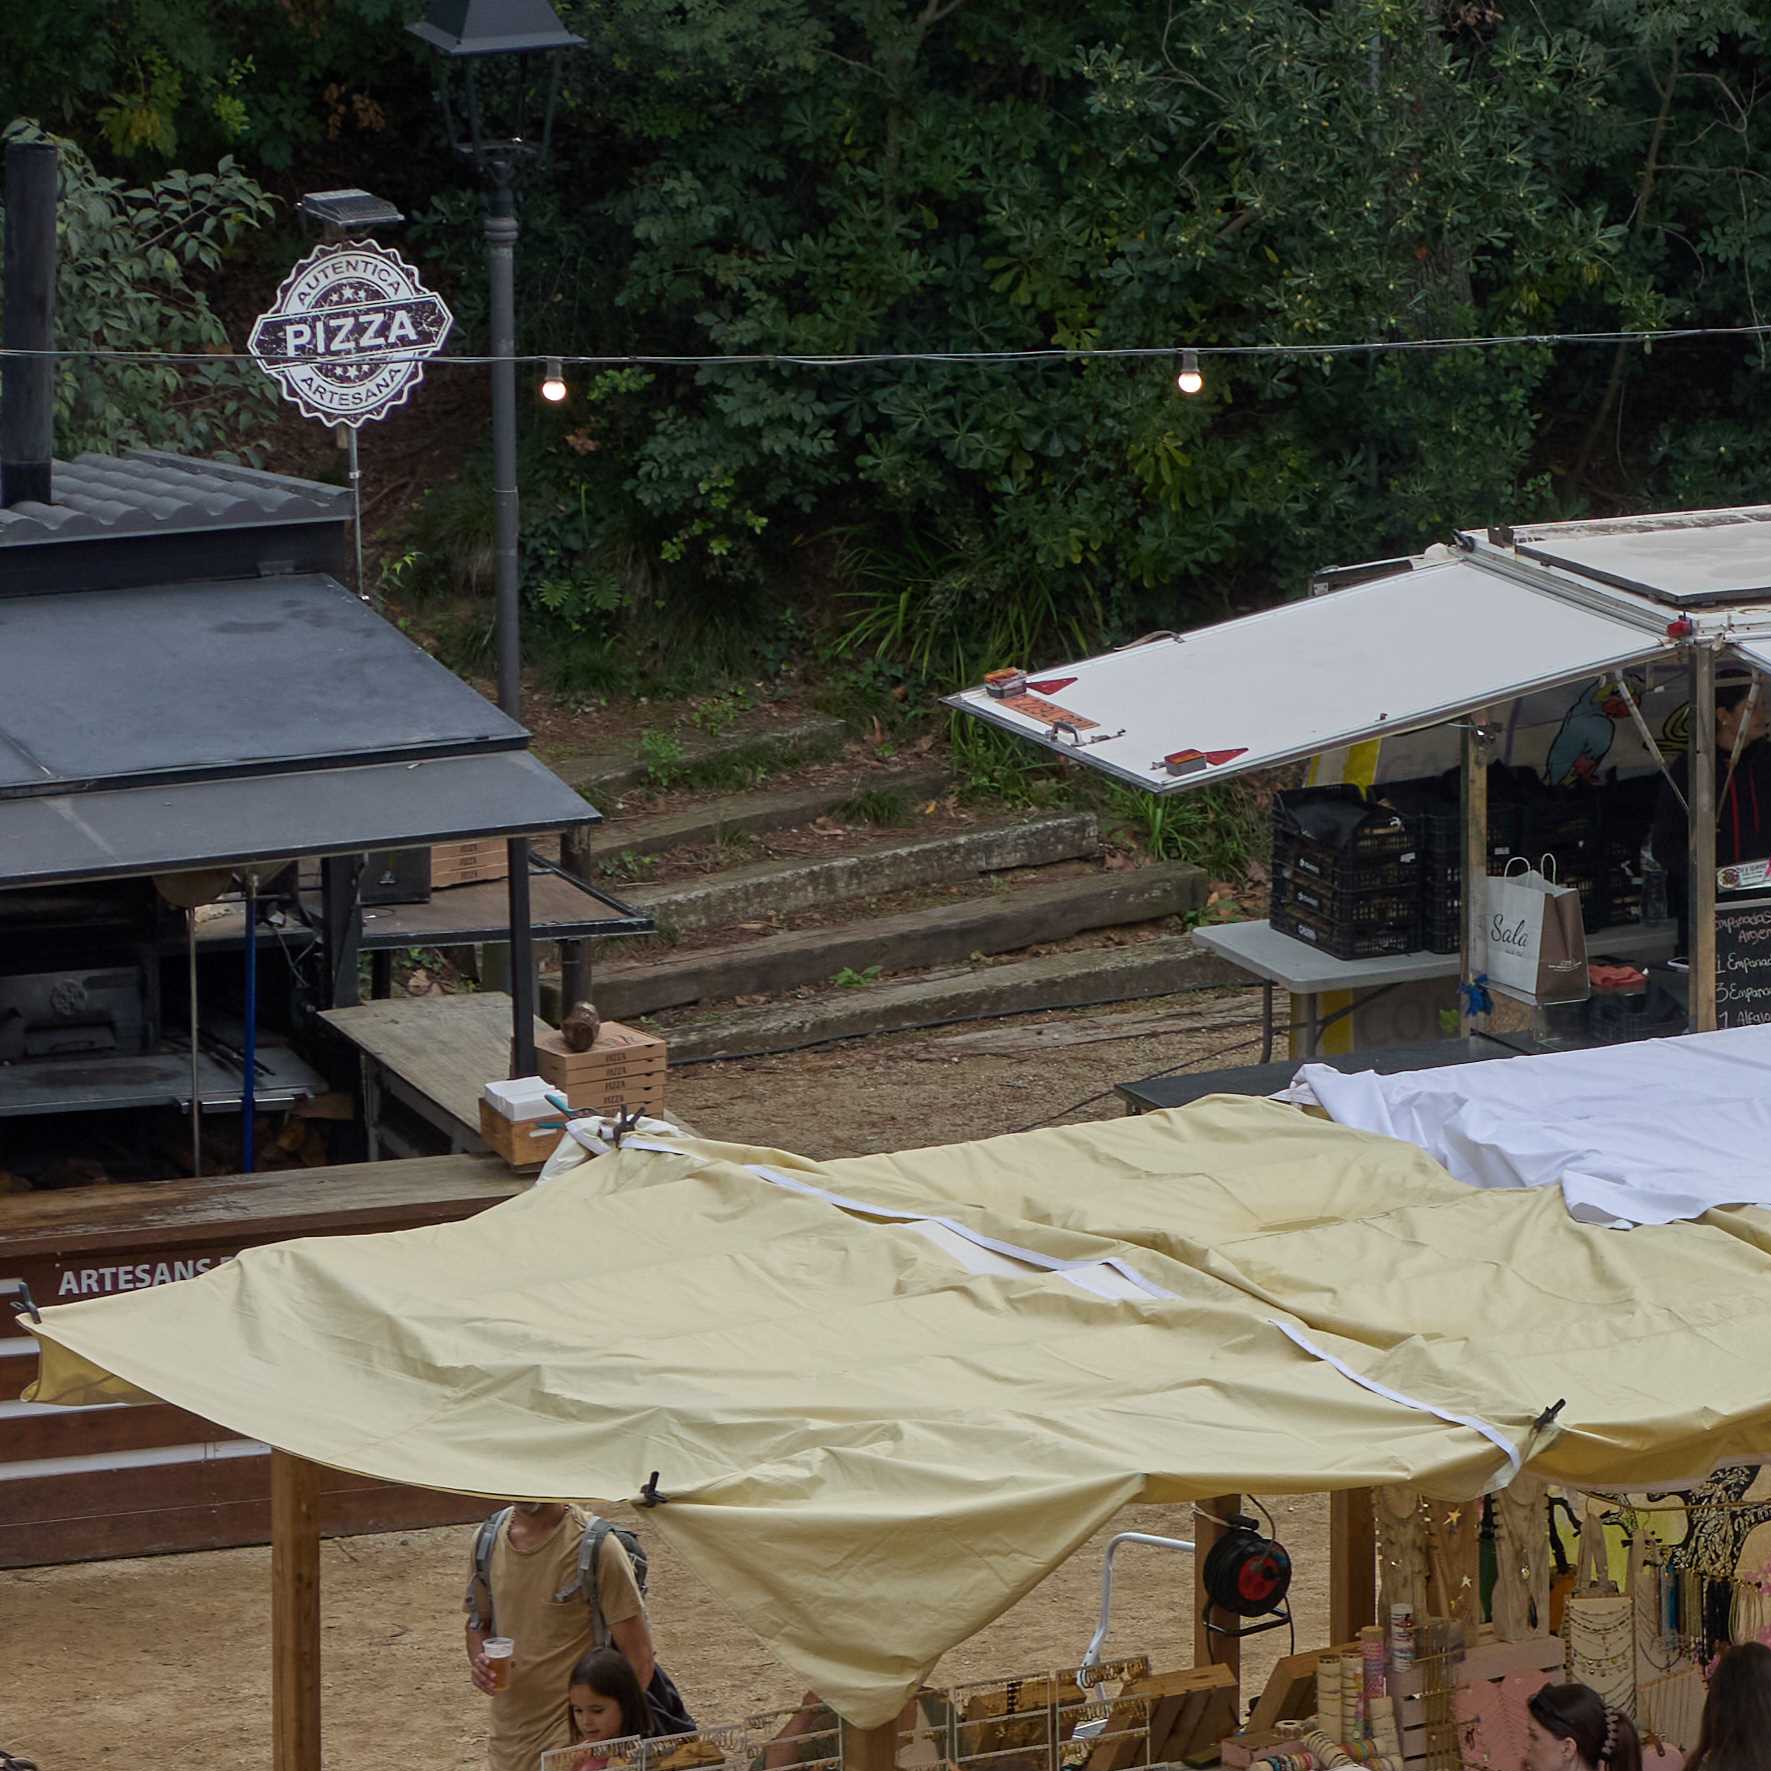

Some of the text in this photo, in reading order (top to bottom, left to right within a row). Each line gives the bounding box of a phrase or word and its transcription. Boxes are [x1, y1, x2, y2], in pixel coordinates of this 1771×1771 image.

[299, 260, 400, 306] AUTENTICA
[285, 309, 417, 357] PIZZA
[301, 367, 401, 406] ARTESANA
[1491, 913, 1529, 947] Sala
[58, 1258, 212, 1296] ARTESANS
